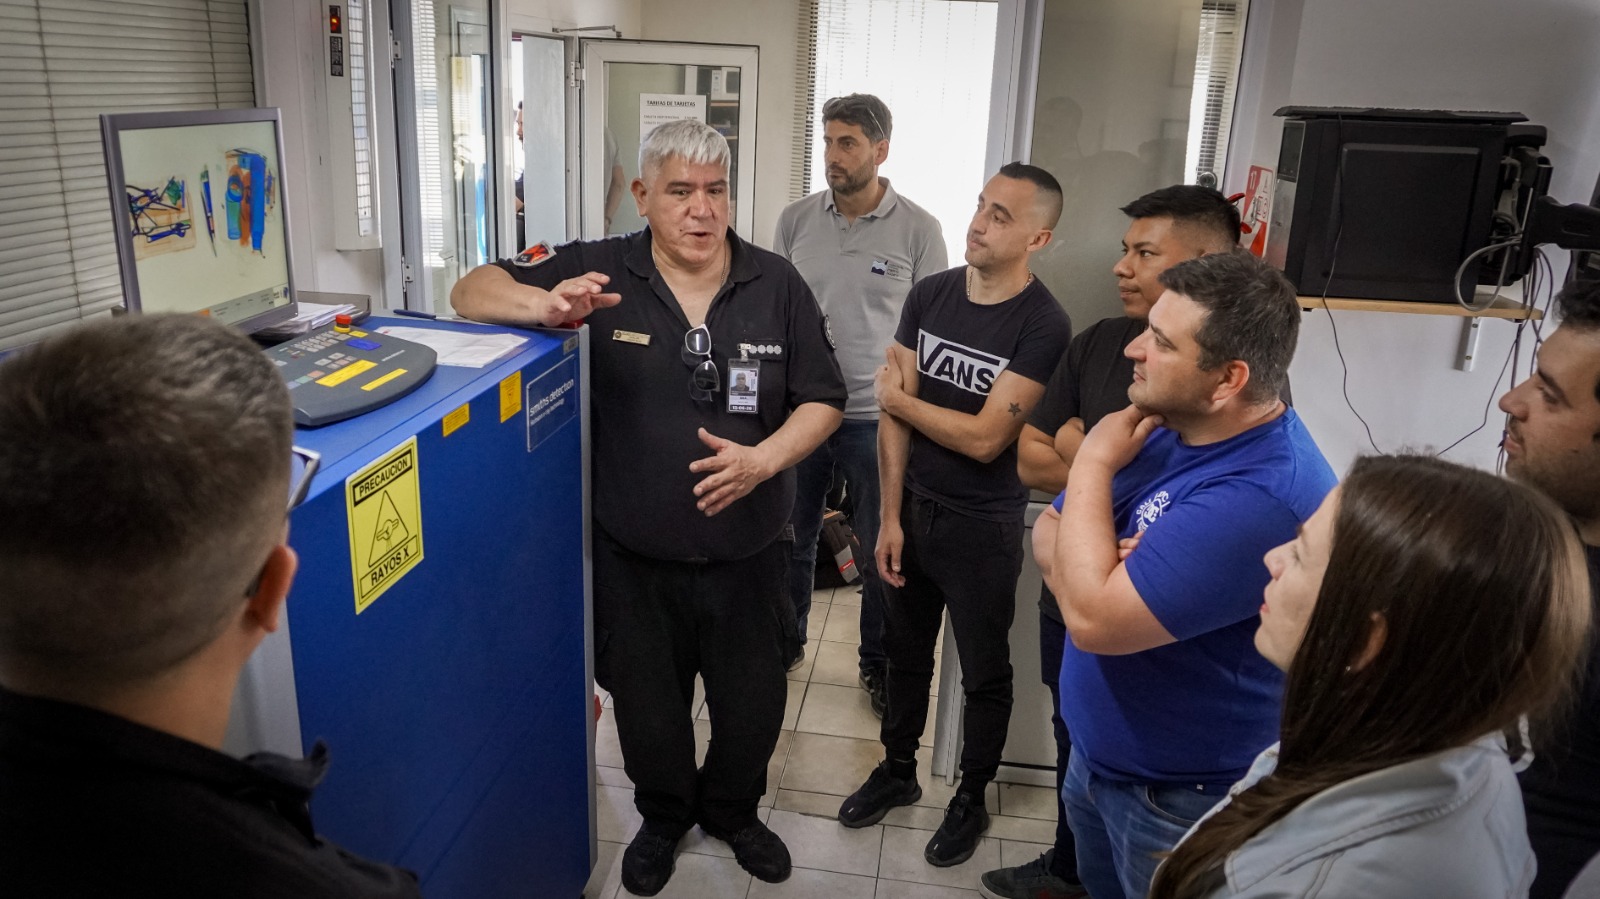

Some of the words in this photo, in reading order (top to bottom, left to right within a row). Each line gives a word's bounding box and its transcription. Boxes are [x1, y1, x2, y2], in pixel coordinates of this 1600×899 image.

[919, 333, 1000, 394] VANS
[529, 396, 549, 417] smiths
[549, 378, 574, 402] detection
[359, 457, 408, 498] PRECAUCION
[371, 552, 402, 586] RAYOS
[403, 545, 410, 559] X
